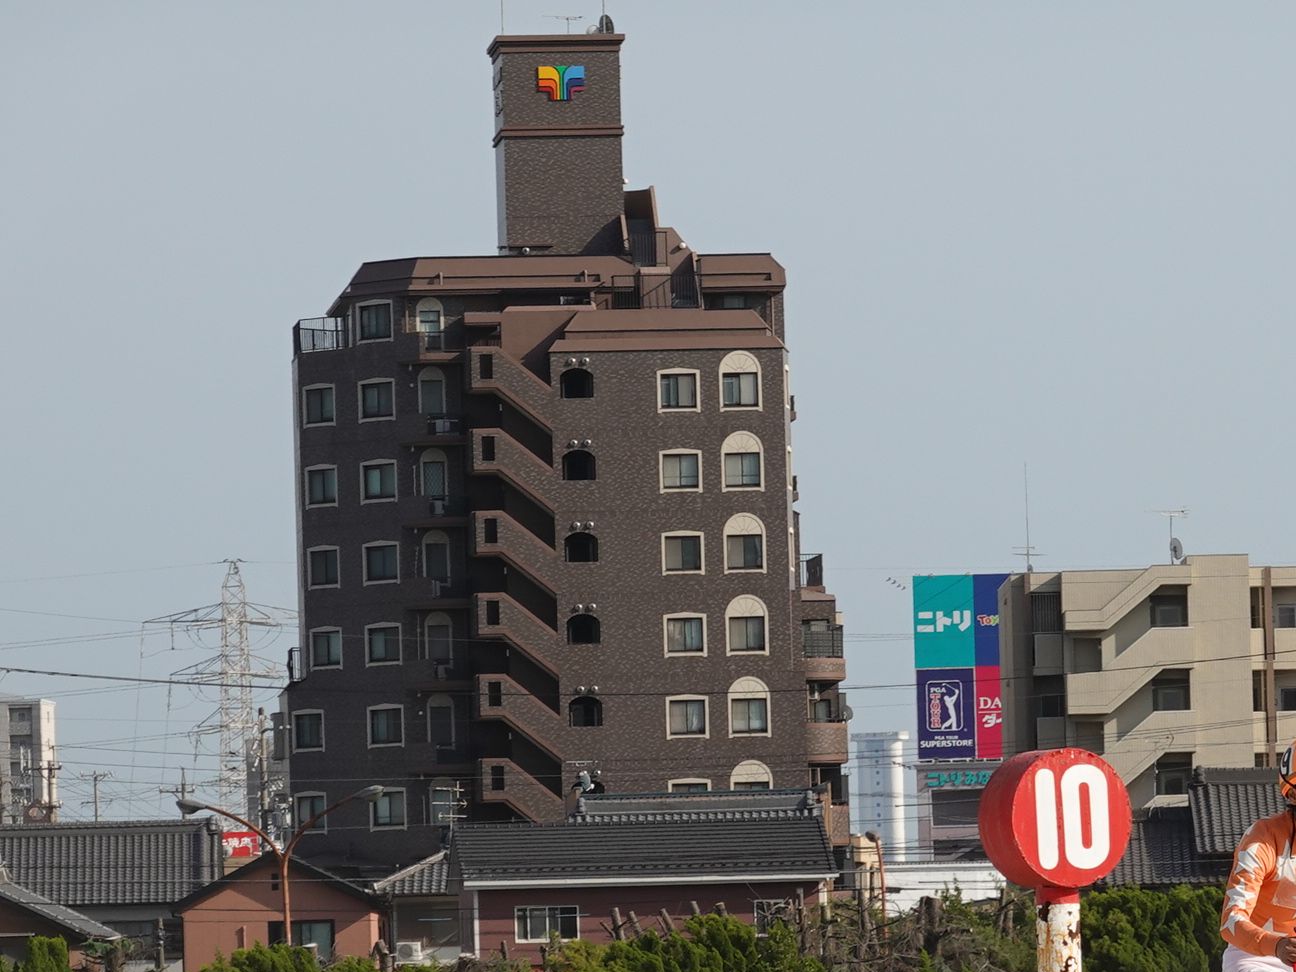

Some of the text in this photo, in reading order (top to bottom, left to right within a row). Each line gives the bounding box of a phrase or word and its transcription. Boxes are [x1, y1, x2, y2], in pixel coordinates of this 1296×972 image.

[917, 610, 971, 632] ニトリ
[920, 739, 973, 748] SUPERSTORE
[1035, 764, 1110, 870] 10
